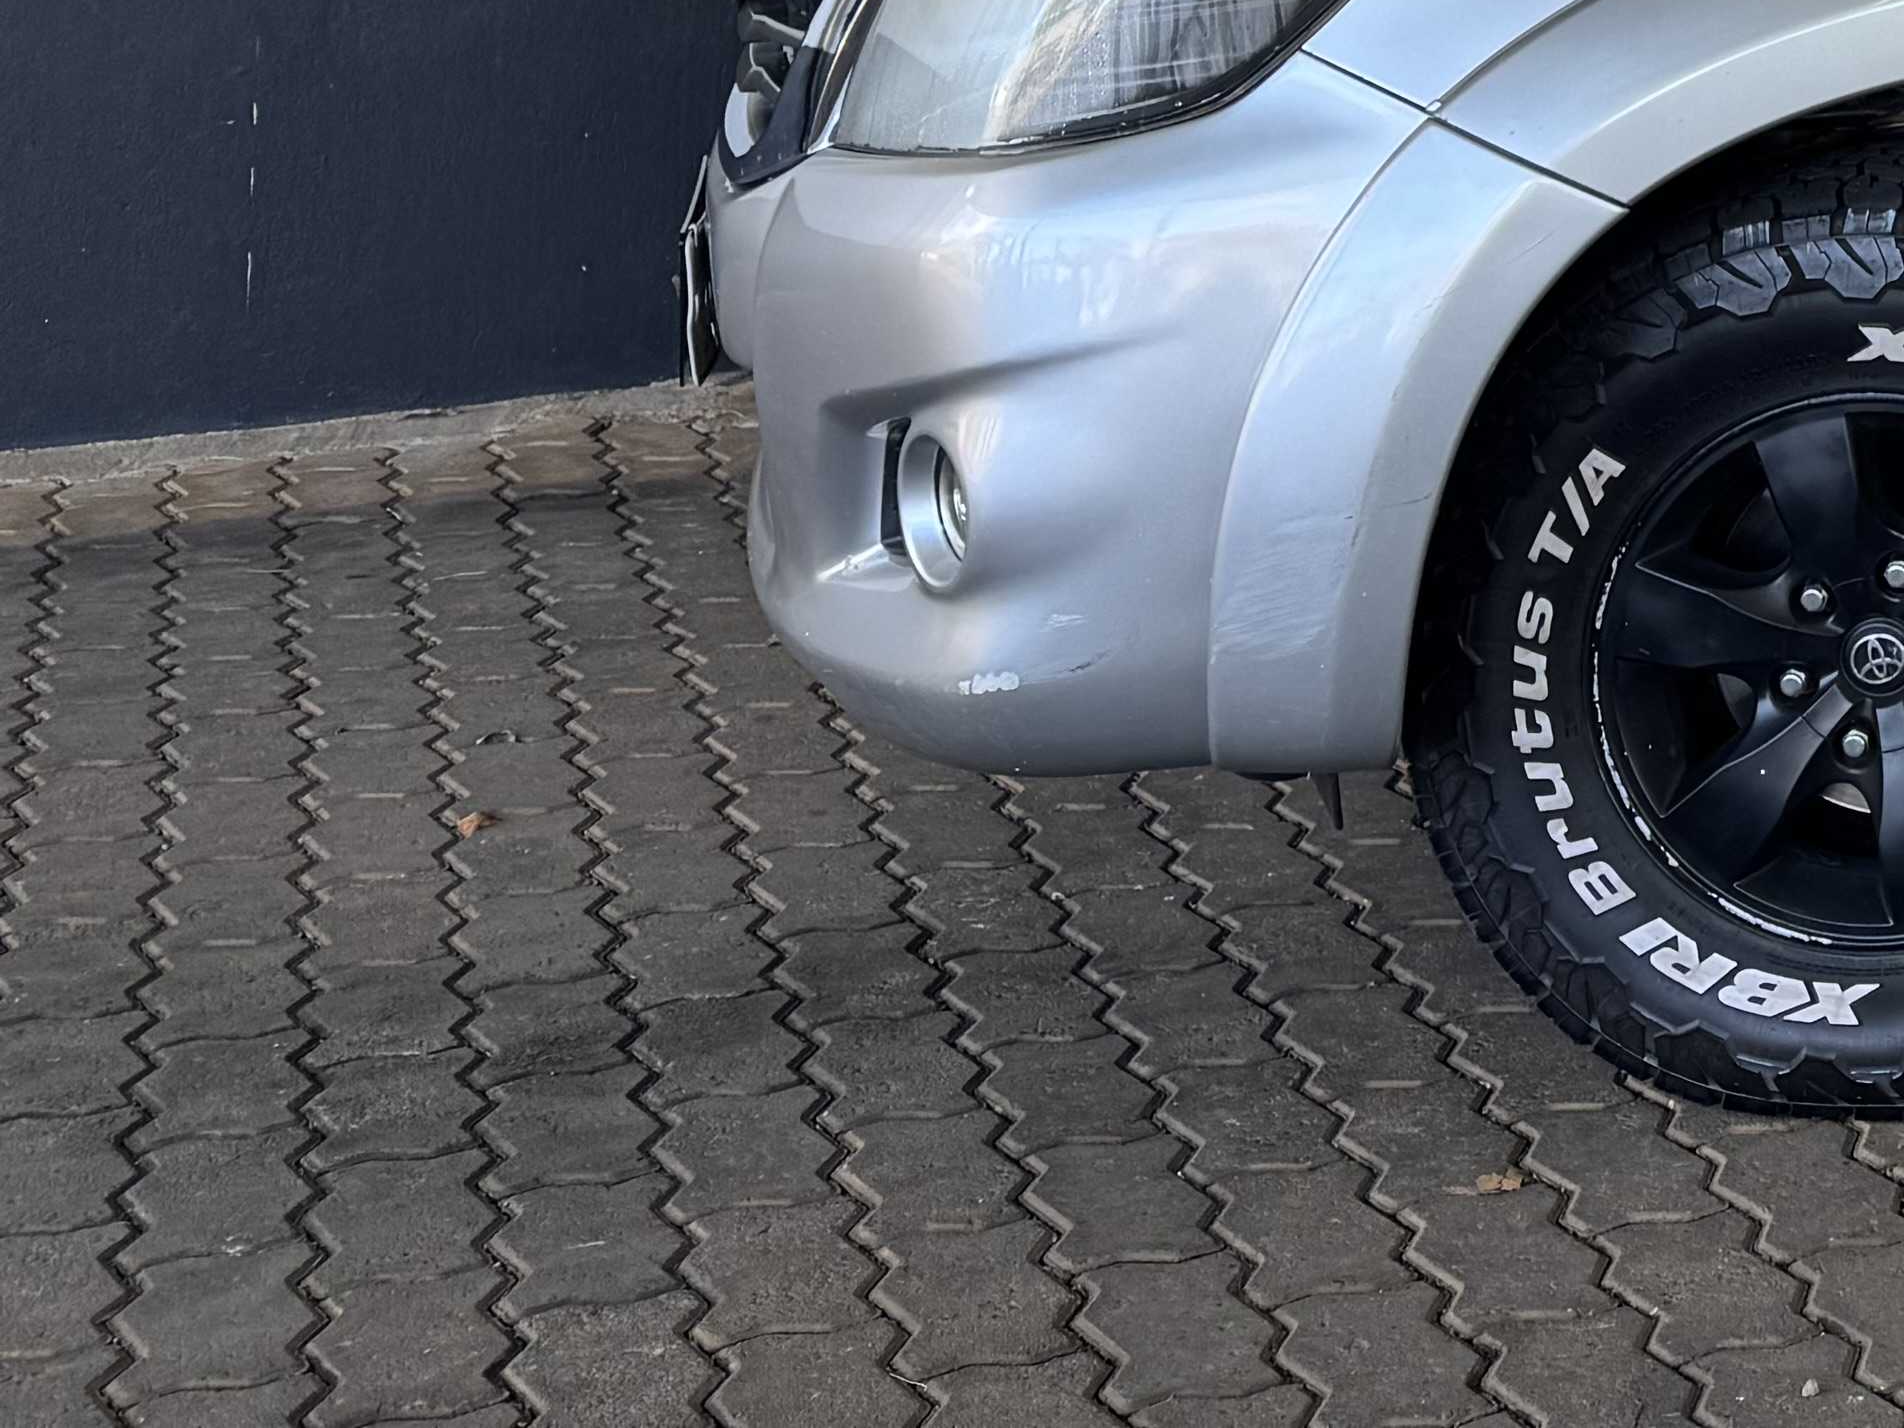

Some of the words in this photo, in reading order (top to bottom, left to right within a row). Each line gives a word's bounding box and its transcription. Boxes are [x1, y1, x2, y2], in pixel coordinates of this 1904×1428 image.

[1527, 447, 1627, 565] T/A
[1510, 591, 1637, 917] Brutus
[1618, 916, 1881, 1027] XBRI
